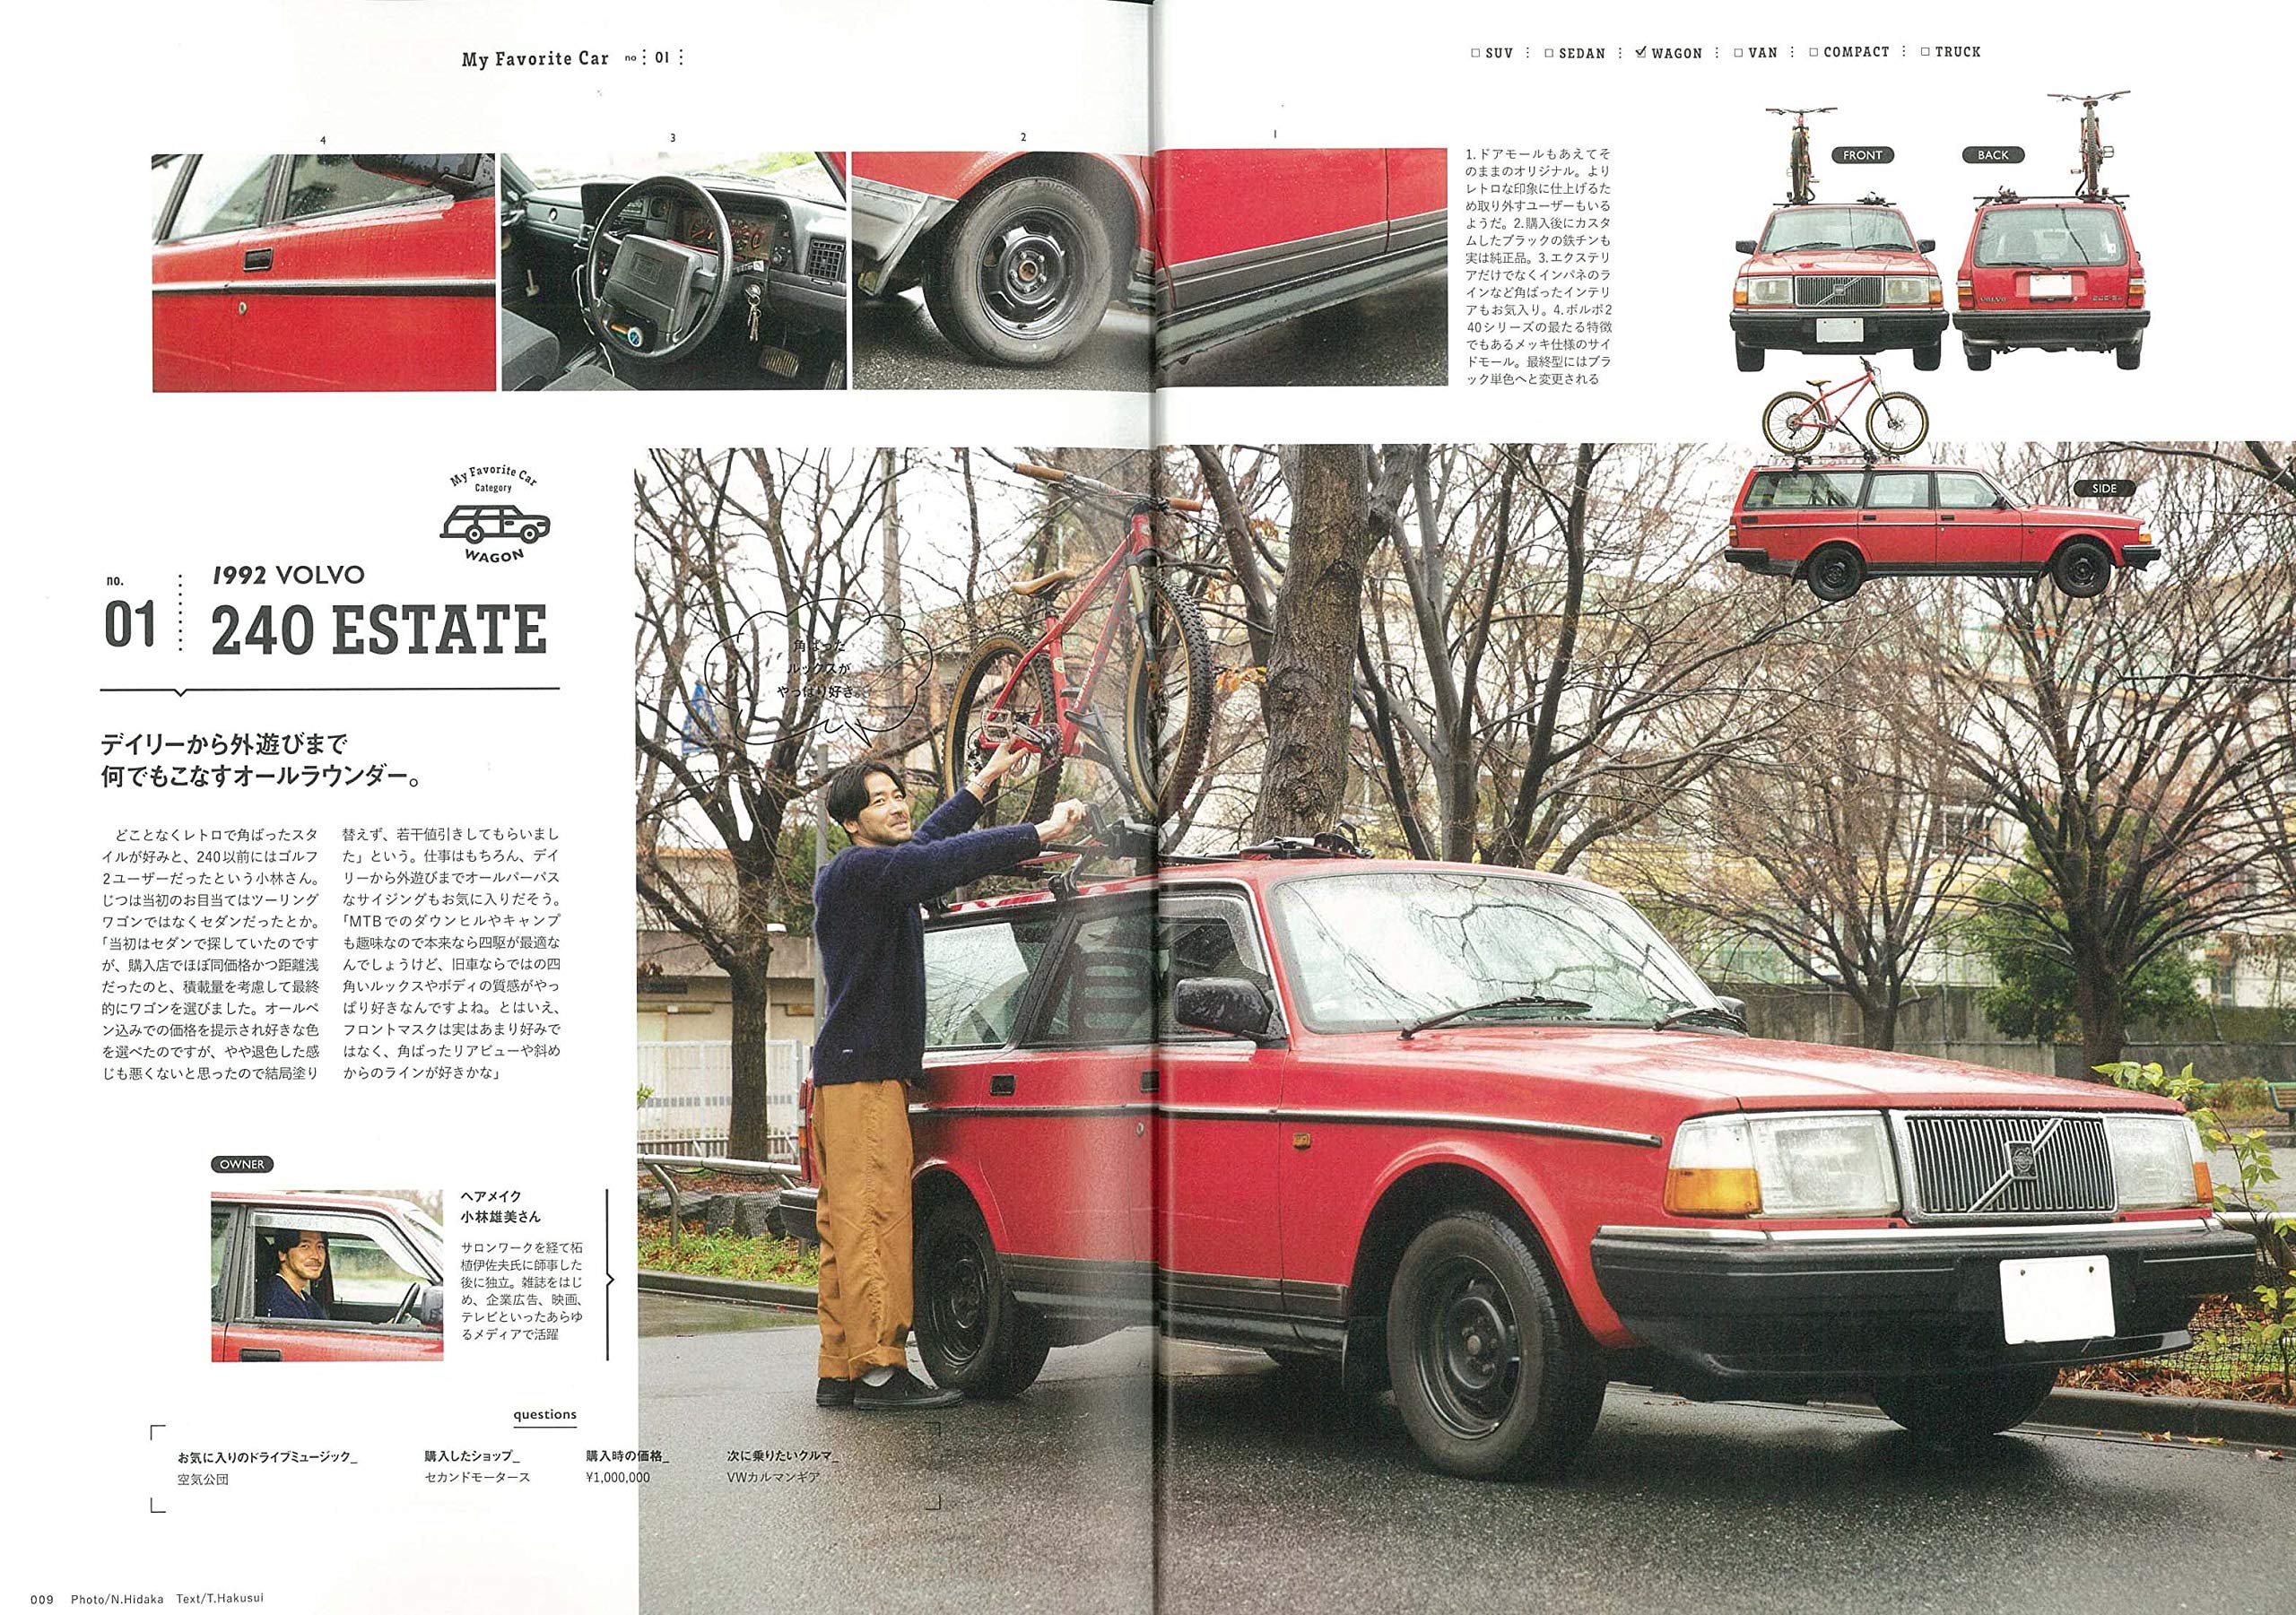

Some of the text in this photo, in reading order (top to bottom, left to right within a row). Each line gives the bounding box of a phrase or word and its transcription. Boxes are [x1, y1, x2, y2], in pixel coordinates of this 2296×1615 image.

[1485, 46, 1981, 59] SUV SEDAN WAGON VAN COMPACT TRUCK
[461, 51, 489, 71] My
[495, 50, 572, 66] Favorite
[578, 49, 609, 65] Car
[655, 51, 669, 64] 01
[320, 135, 326, 145] 4
[670, 133, 676, 143] 3
[1021, 132, 1027, 142] 2
[1843, 150, 1883, 161] FRONT
[1978, 150, 2010, 161] BACK
[449, 465, 537, 487] My Favorite Car
[474, 483, 512, 494] Category
[2092, 483, 2118, 494] SIDE
[465, 548, 525, 563] WAGON
[107, 577, 124, 586] no.
[213, 565, 365, 585] 1992 VOLVO
[105, 599, 154, 647] 01
[212, 603, 547, 656] 240 ESTATE
[787, 663, 851, 675] ルックスが
[100, 731, 348, 756] デイリーから外遊びまで
[100, 762, 419, 788] 何でもこなすオールラウンダー。
[220, 1159, 265, 1169] OWNER
[460, 1190, 521, 1203] ヘアメイク
[460, 1210, 541, 1224] 小林雄美さん
[513, 1409, 577, 1423] questions
[178, 1473, 229, 1486] 空気公団
[424, 1472, 530, 1483] セカンドモータース
[586, 1471, 651, 1485] ¥1,000,000
[726, 1469, 822, 1486] VWカルマンギア
[30, 1593, 264, 1605] 009 Photo/N.Hidaka Text/T.Hakusui
